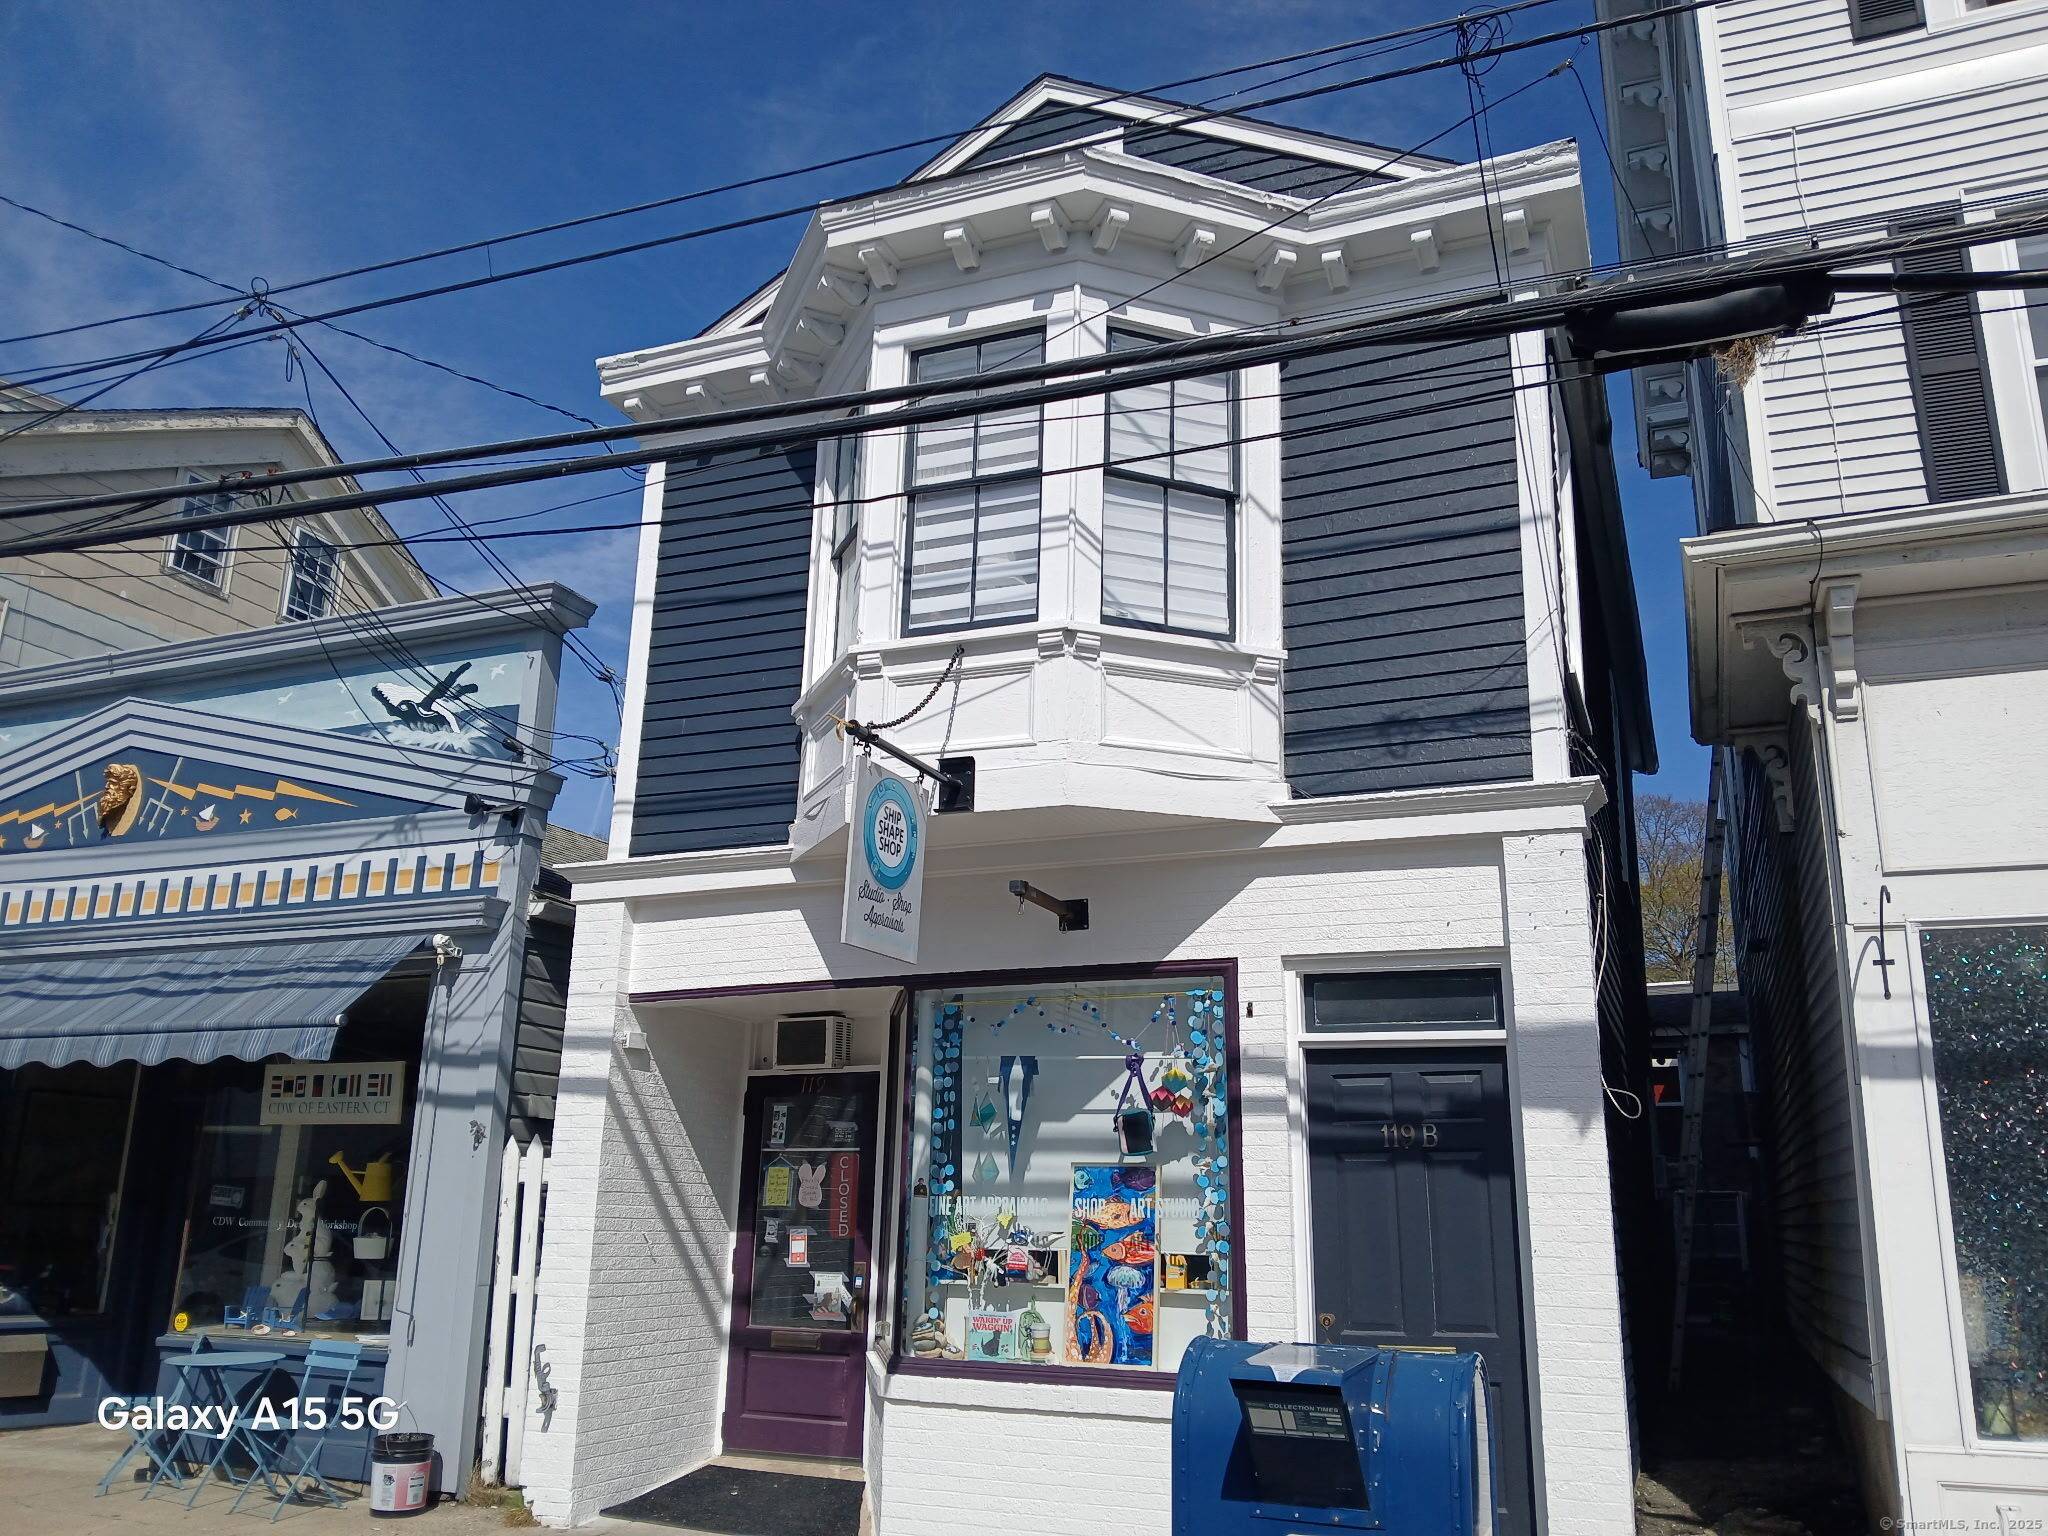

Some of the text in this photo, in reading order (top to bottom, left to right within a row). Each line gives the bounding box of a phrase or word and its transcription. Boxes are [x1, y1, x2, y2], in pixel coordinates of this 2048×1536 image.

[884, 806, 902, 825] SHIP
[878, 820, 904, 844] SHAPE
[879, 837, 902, 857] SHOP
[858, 879, 912, 917] Studio Shop
[863, 905, 906, 933] Appraisals
[801, 1076, 826, 1094] 119
[268, 1101, 391, 1115] CDW OF EASTERN CT
[1380, 1123, 1439, 1149] 119 B
[838, 1156, 850, 1237] CLOSED
[929, 1195, 952, 1217] FINE
[1074, 1198, 1106, 1219] SHOP
[1129, 1198, 1153, 1219] ART
[1158, 1198, 1200, 1219] STUDIO
[212, 1216, 236, 1227] CDW
[1268, 1403, 1315, 1411] COLLECTION
